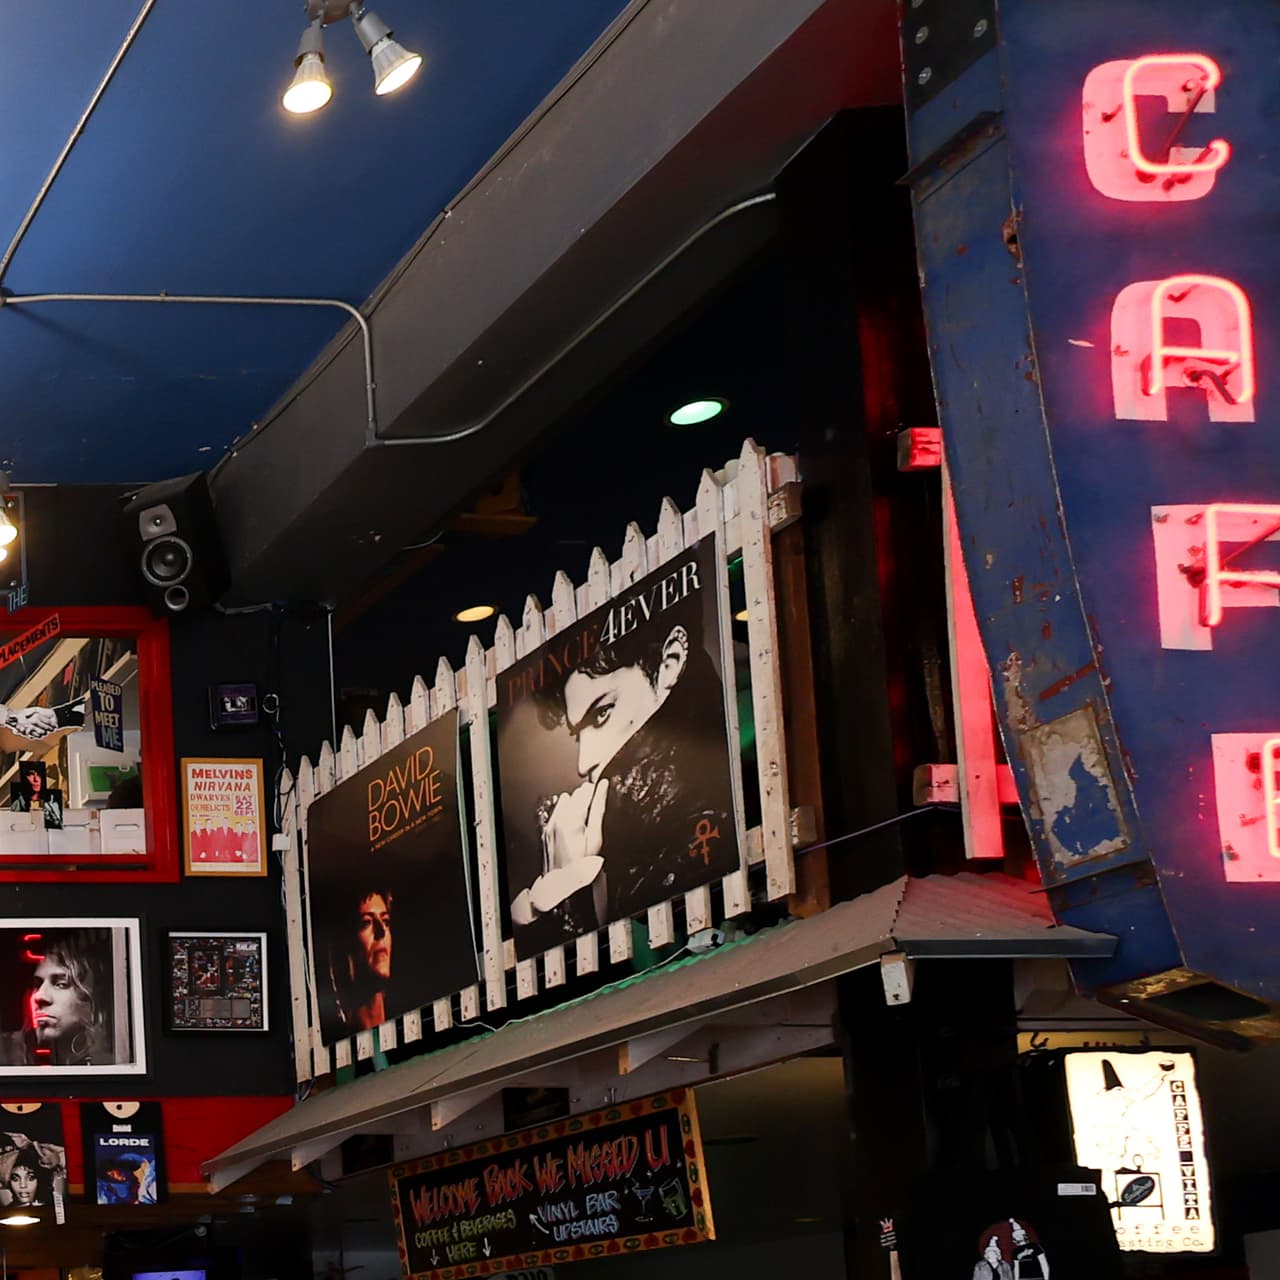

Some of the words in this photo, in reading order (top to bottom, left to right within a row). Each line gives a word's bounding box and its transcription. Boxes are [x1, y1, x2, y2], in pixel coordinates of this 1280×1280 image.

[8, 585, 28, 612] THE
[599, 559, 701, 648] 4EVER
[92, 681, 121, 695] PLEASED
[98, 695, 113, 711] TO
[95, 712, 120, 727] MEET
[103, 729, 122, 747] ME
[192, 769, 253, 779] MELVINS
[368, 746, 433, 811] DAVID
[194, 782, 251, 792] NIRVANA
[236, 801, 252, 810] 22
[369, 769, 442, 841] BOWIE
[99, 1137, 150, 1146] LORDE
[409, 1177, 480, 1226] WELCOME
[484, 1159, 533, 1204] BACK
[533, 1152, 565, 1194] WE
[567, 1135, 639, 1188] MISSED
[645, 1123, 671, 1170] U
[538, 1203, 580, 1224] VINYL
[586, 1190, 620, 1214] BAR
[414, 1225, 451, 1249] COFFEE
[460, 1209, 517, 1239] BEVERAGES
[553, 1215, 619, 1243] UPSTAIRS
